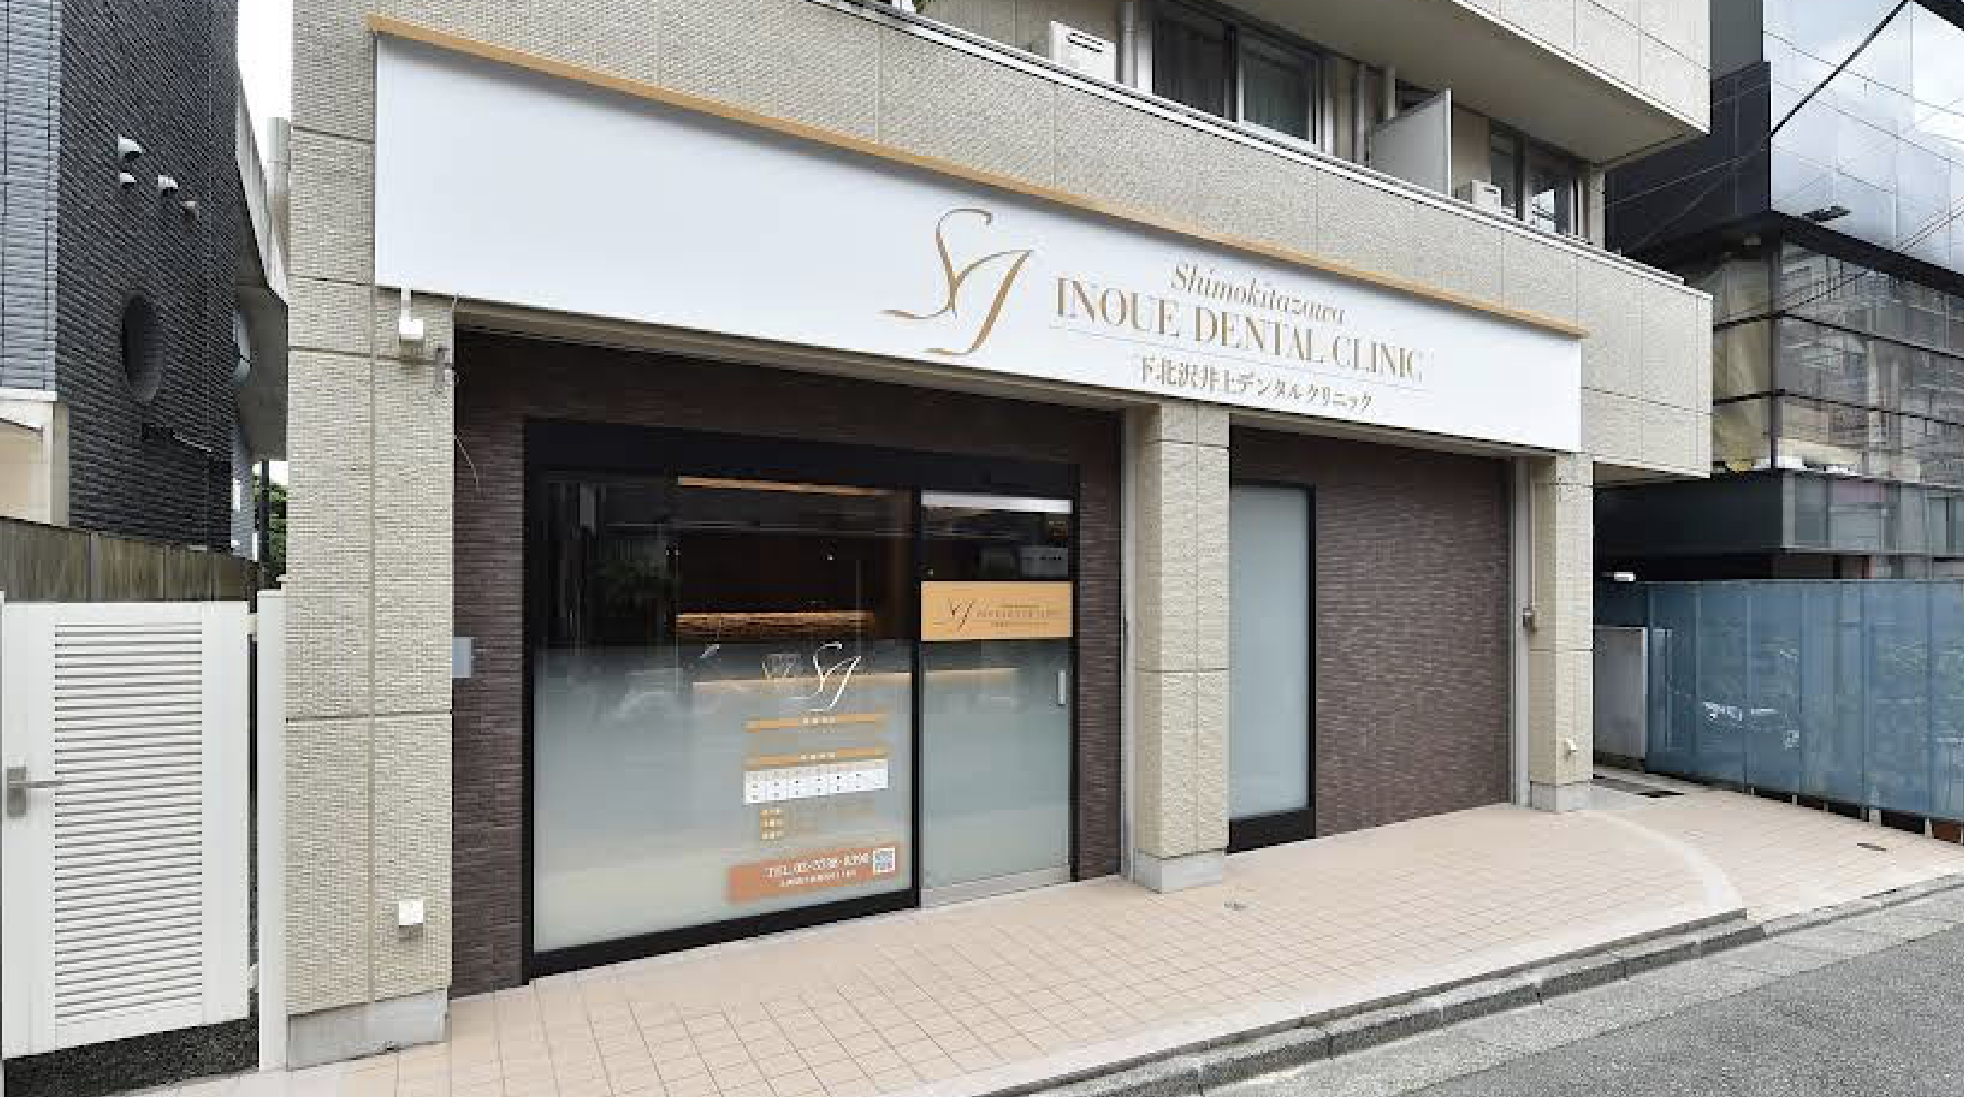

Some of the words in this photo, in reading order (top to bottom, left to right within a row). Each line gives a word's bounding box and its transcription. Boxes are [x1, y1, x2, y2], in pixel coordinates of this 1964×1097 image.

[1056, 276, 1180, 338] INOUE
[1195, 304, 1325, 364] DENTAL
[1333, 334, 1423, 382] CLINIC
[1170, 262, 1345, 324] Shimokitazawa
